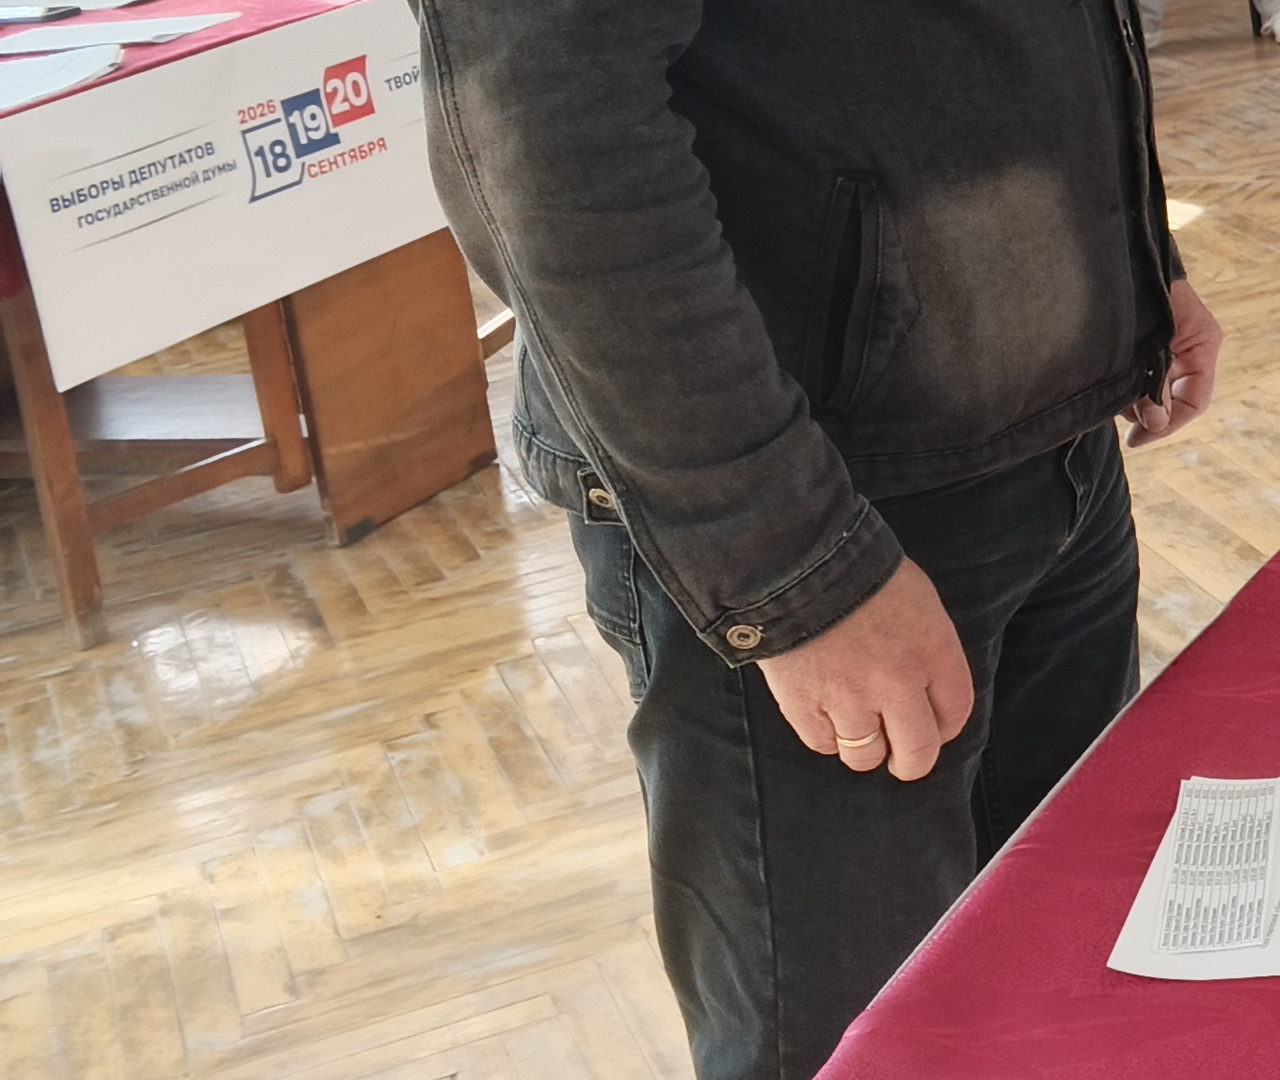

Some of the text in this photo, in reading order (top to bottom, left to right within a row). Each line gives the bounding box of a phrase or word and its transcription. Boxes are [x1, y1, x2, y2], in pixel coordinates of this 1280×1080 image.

[237, 100, 276, 124] 2026
[254, 71, 369, 178] 18 19 20
[50, 142, 216, 213] ВЫБОРЫ ДЕПУТАТОВ
[306, 137, 388, 178] СЕНТЯБРЯ
[76, 159, 238, 228] ГОСУДАРСТВЕННОЙ ДУМЫ
